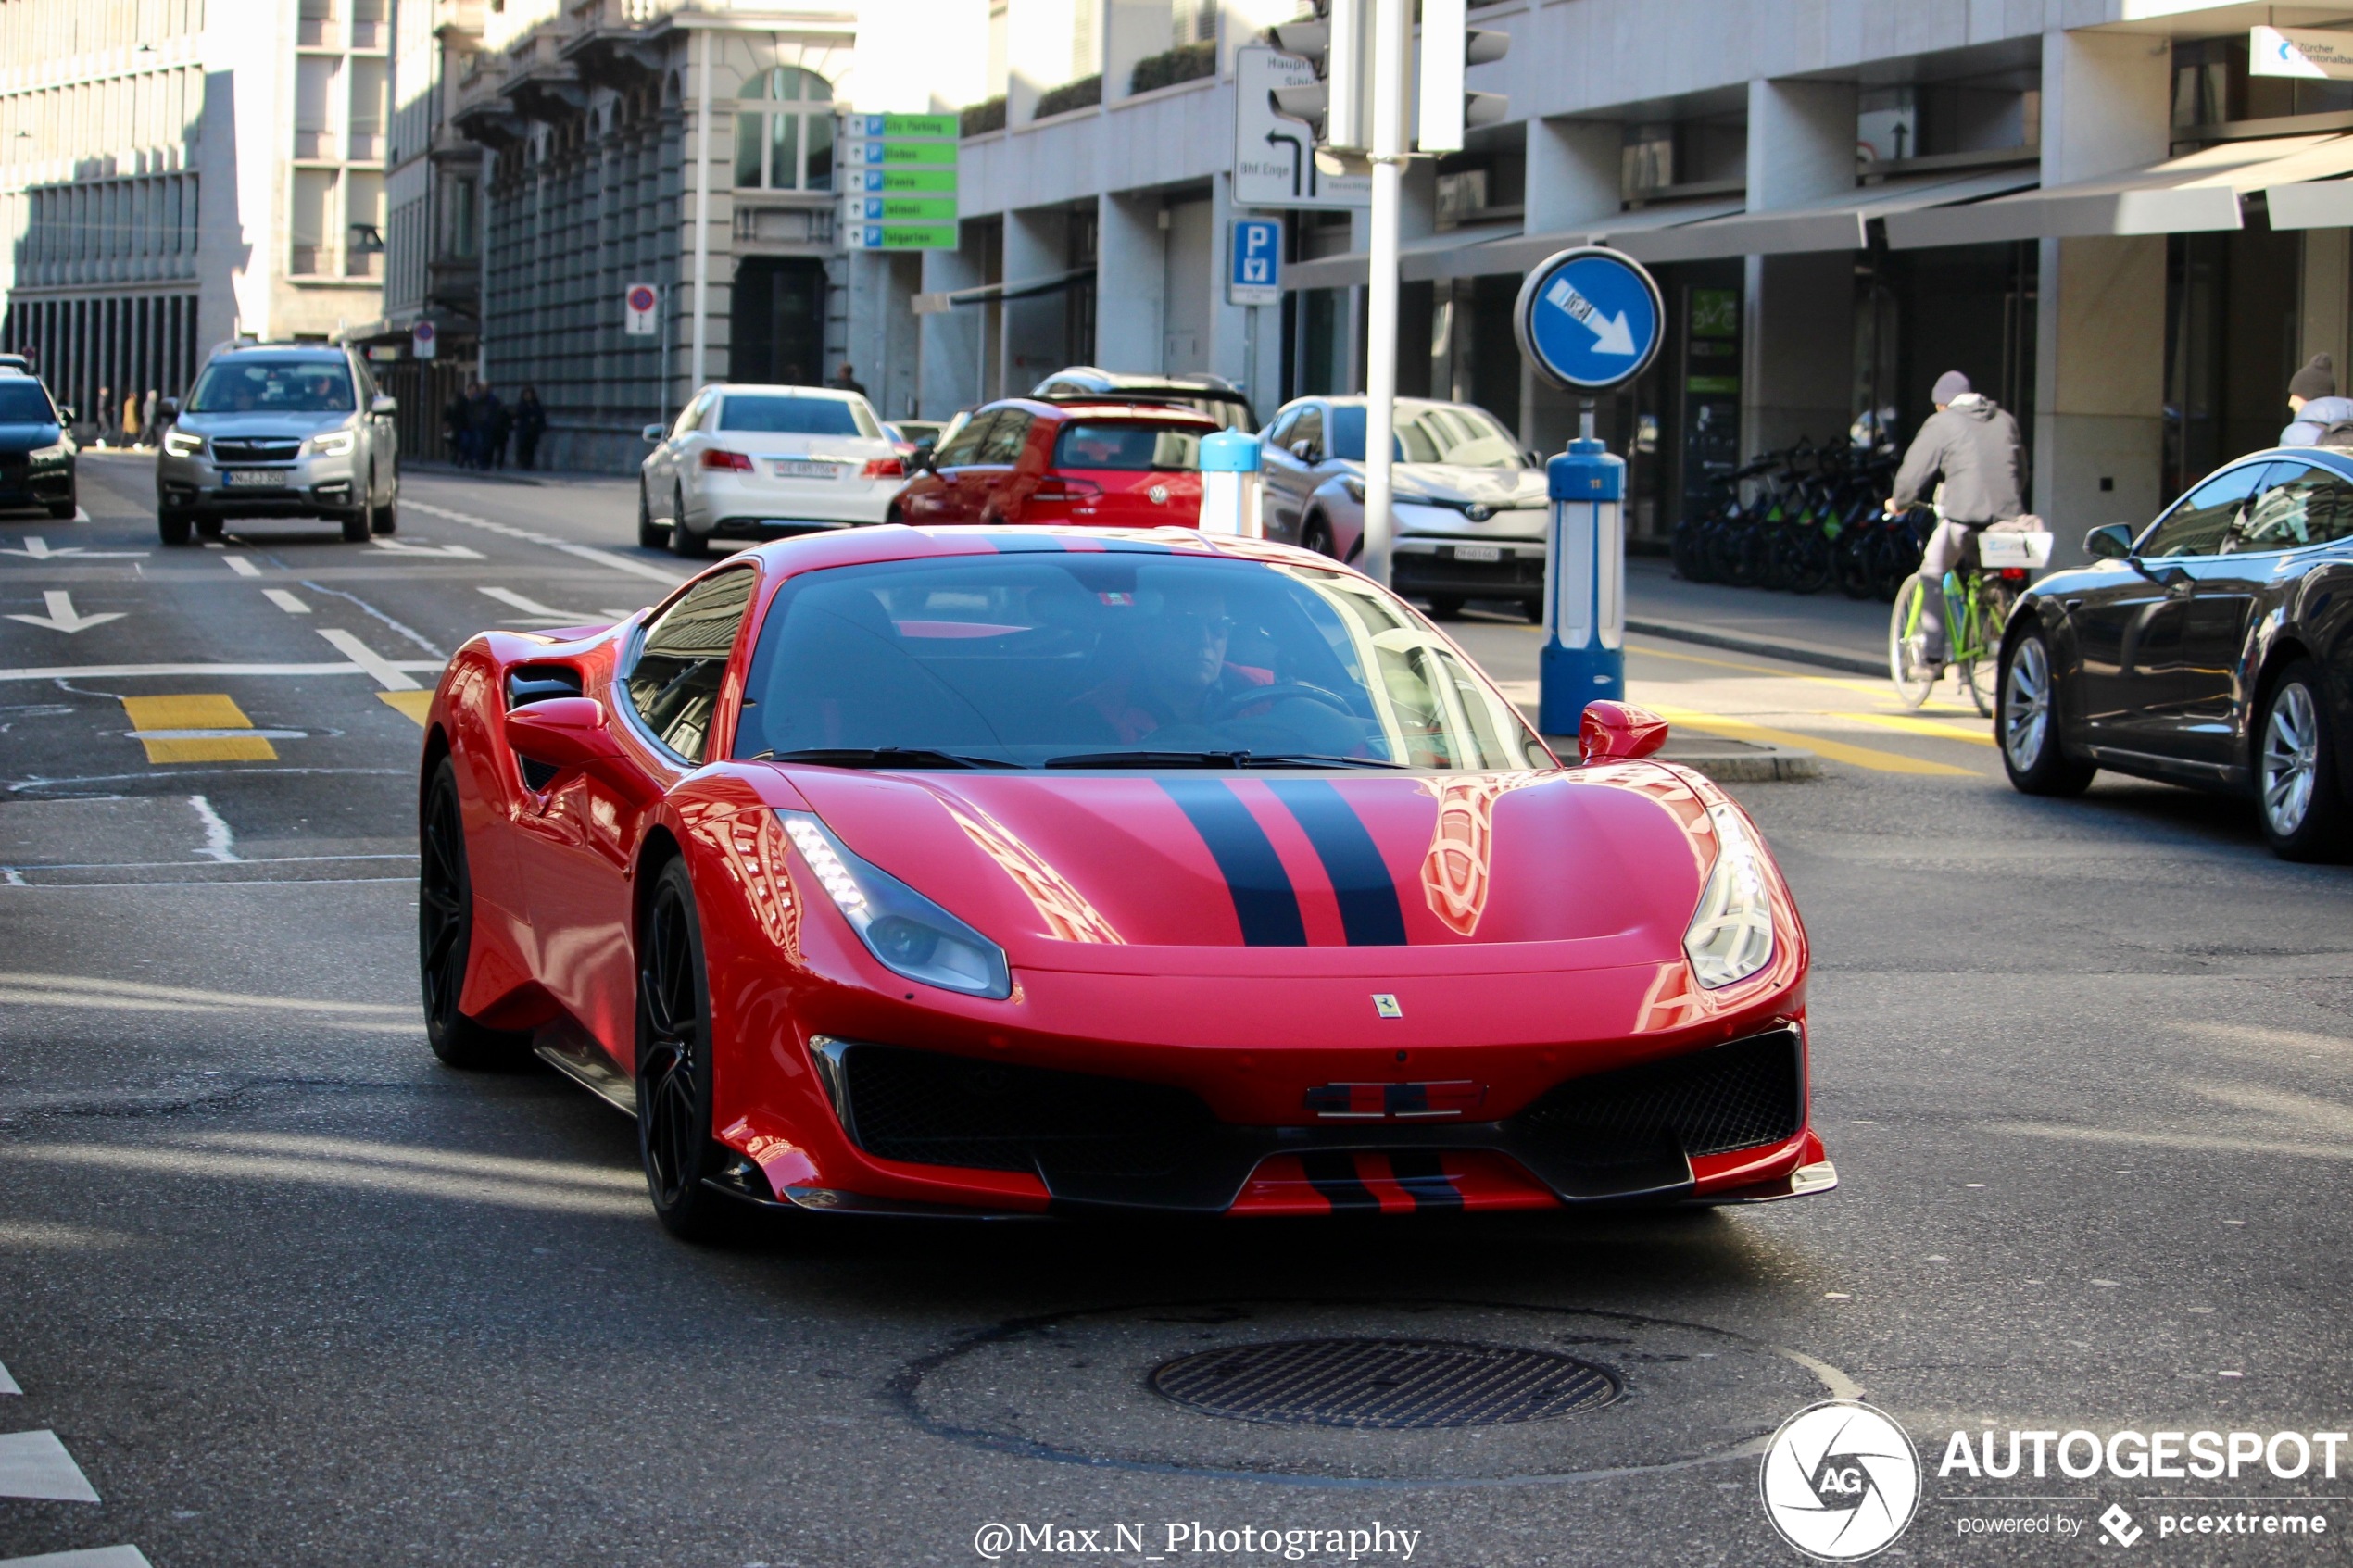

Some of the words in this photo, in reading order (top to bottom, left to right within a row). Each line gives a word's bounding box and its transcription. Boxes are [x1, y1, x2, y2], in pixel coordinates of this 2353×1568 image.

[2298, 43, 2334, 53] Zürcher
[884, 121, 902, 133] City
[907, 121, 942, 134] Parking
[884, 148, 917, 159] Globus
[1263, 163, 1289, 178] Enge
[884, 176, 915, 187] Urania
[884, 232, 931, 245] Talgarten
